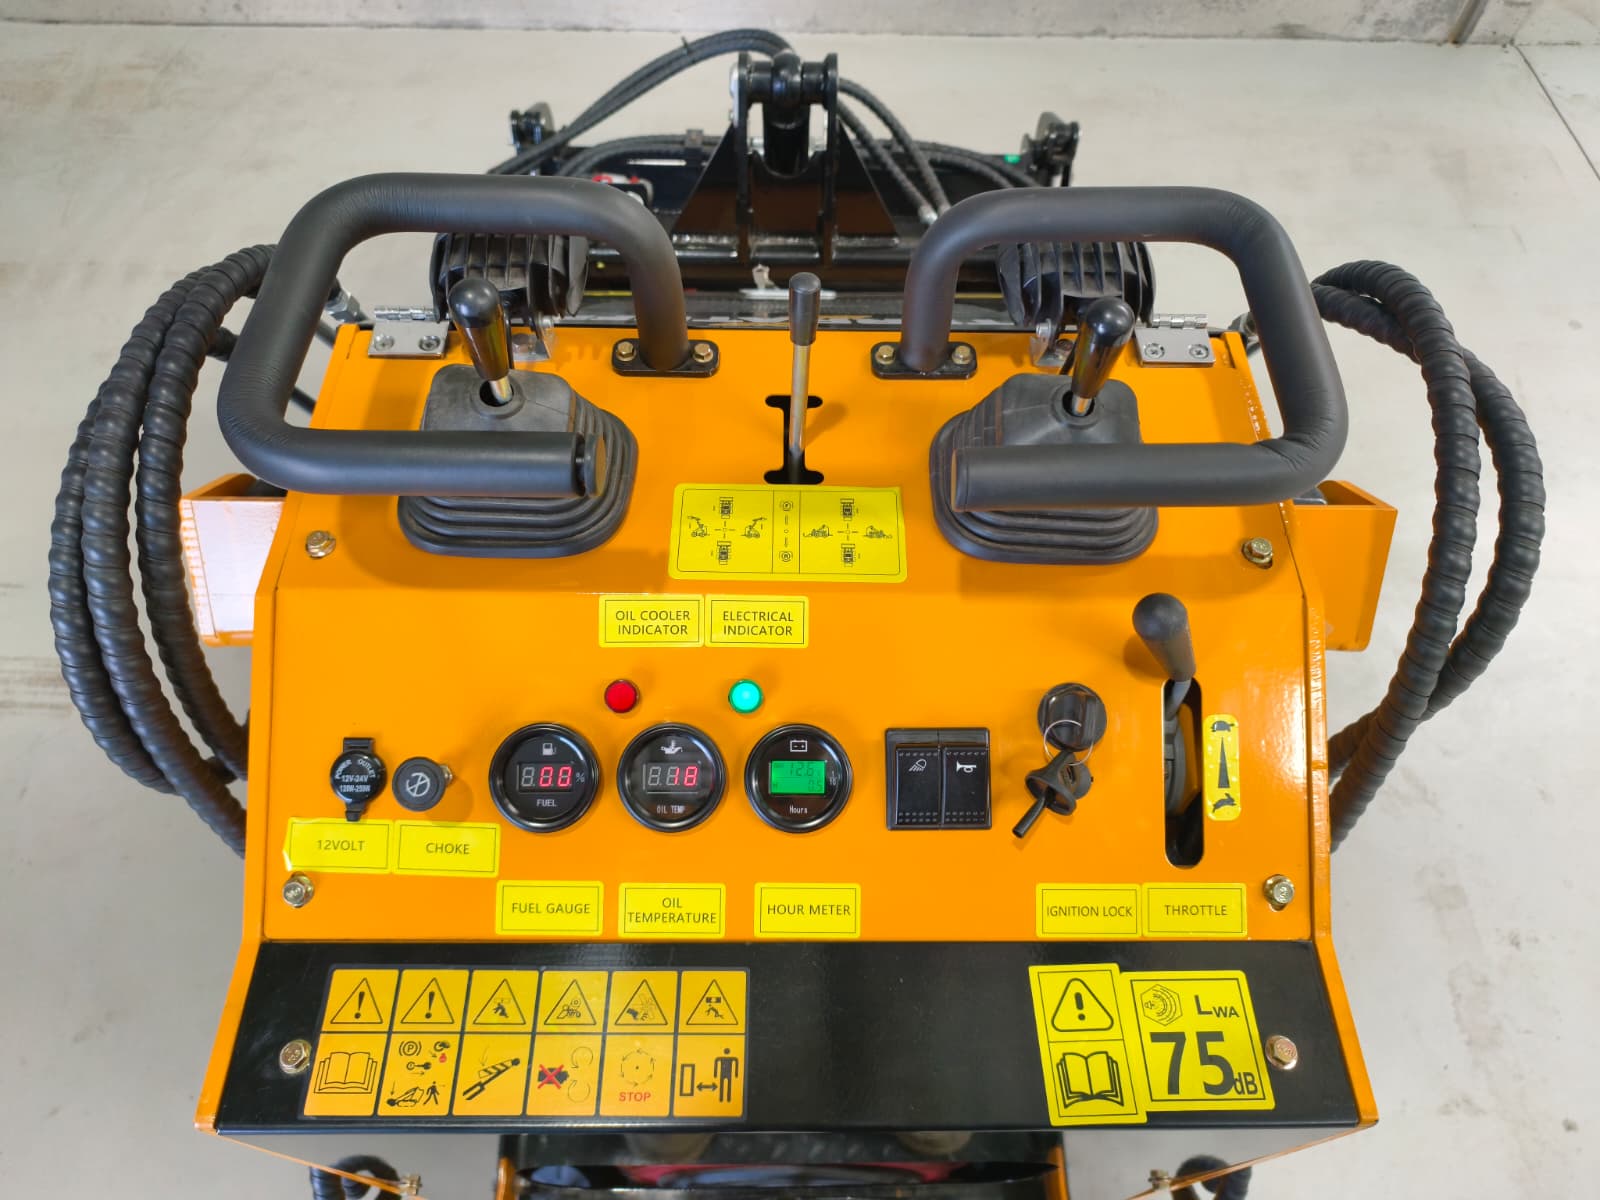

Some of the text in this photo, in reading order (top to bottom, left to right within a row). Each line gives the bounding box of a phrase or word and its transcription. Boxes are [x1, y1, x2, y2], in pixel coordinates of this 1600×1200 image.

[615, 610, 691, 621] OIL COOLER
[722, 611, 794, 622] ELECTRICAL
[618, 624, 689, 635] INDICATOR
[723, 625, 793, 636] INDICATOR
[358, 758, 377, 779] OUTLET
[673, 766, 698, 786] 18
[536, 798, 557, 807] FUEL
[656, 804, 669, 815] OIL
[789, 804, 808, 815] Hours
[317, 840, 365, 851] 12VOLT
[425, 843, 470, 855] CHOKE
[512, 902, 591, 914] FUEL GAUGE
[662, 897, 683, 909] OIL
[767, 903, 851, 916] HOUR METER
[1047, 905, 1133, 917] IGNITION LOCK
[1164, 905, 1228, 916] THROTTLE
[627, 911, 717, 924] TEMPERATURE
[1150, 1031, 1235, 1096] 75
[618, 1091, 652, 1102] STOP
